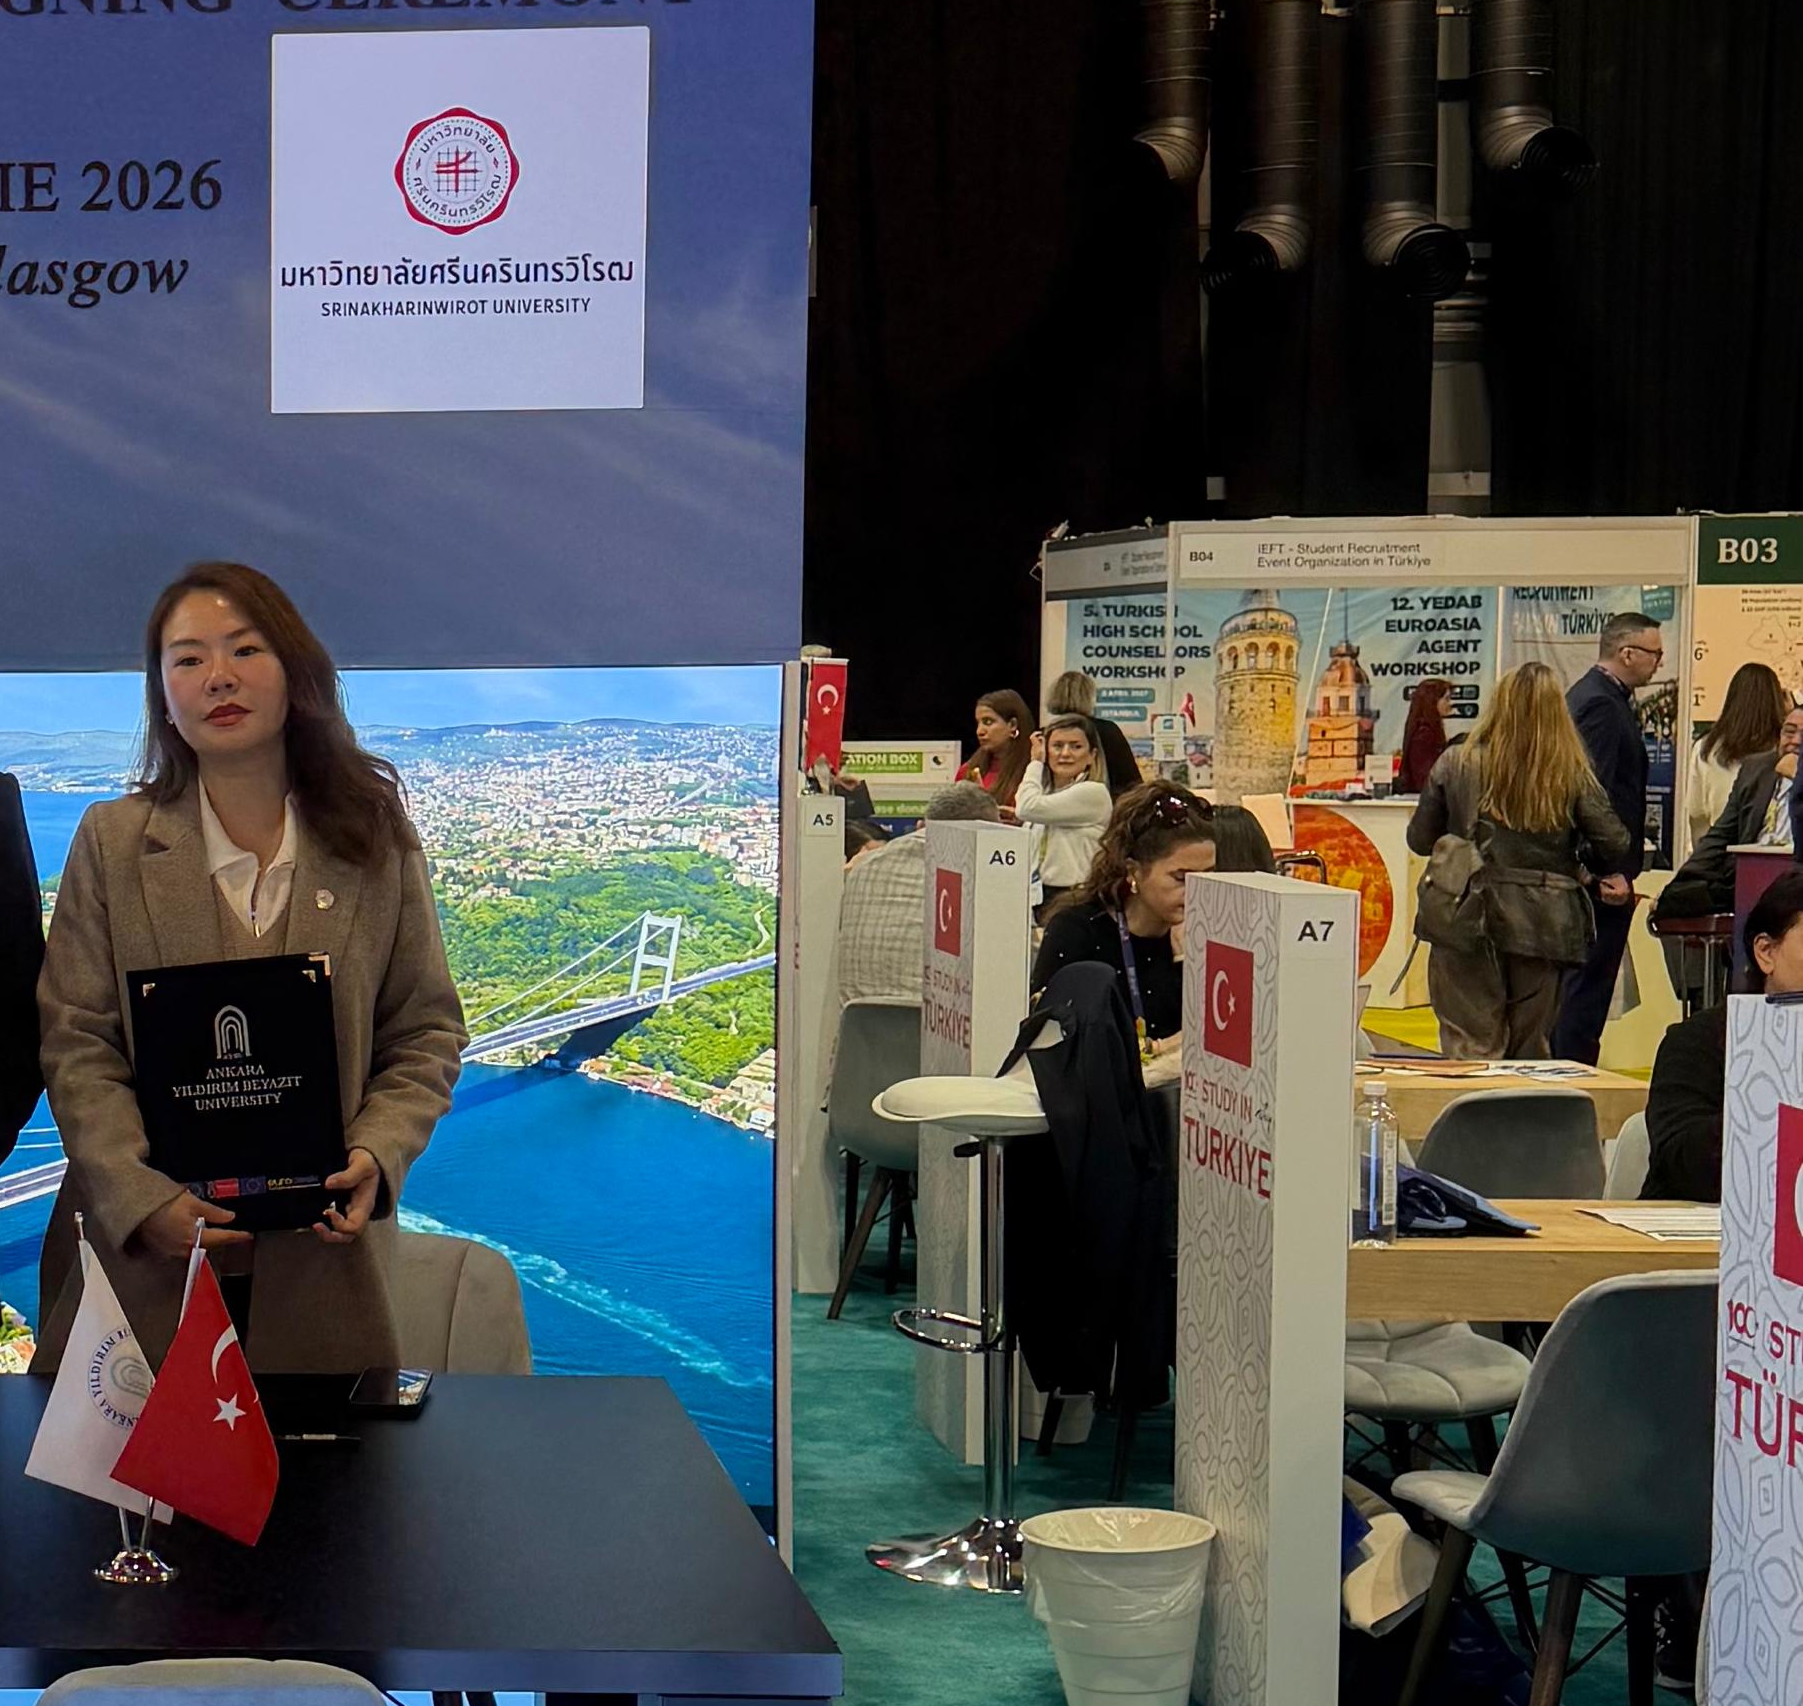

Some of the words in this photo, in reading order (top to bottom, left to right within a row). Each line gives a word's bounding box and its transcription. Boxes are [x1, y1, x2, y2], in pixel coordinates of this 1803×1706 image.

[80, 159, 223, 212] 2026
[281, 253, 634, 287] มหาวิทยาลัยศรีนครินทรวิโรฒ
[321, 299, 488, 317] SRINAKHARINWIROT
[493, 297, 591, 314] UNIVERSITY
[1297, 543, 1345, 554] Student
[1347, 542, 1421, 554] Recruitment
[1718, 537, 1778, 564] B03
[1189, 551, 1213, 562] B04
[1257, 557, 1291, 568] Event
[1294, 555, 1372, 570] Organization
[1373, 555, 1384, 566] in
[1391, 596, 1414, 611] 12.
[1419, 595, 1483, 610] YEDAB
[1083, 625, 1125, 638] HIGH
[1129, 624, 1203, 638] SCHOL
[1385, 617, 1482, 633] EUROASIA
[1083, 645, 1211, 659] COUNSELORS
[1417, 639, 1482, 654] AGENT
[1370, 661, 1481, 677] WORKSHOP
[846, 753, 887, 765] ATION
[890, 753, 918, 765] BOX
[813, 814, 834, 826] A5
[989, 850, 1016, 866] A6
[1298, 921, 1335, 942] A7
[206, 1064, 265, 1080] ANKARA
[172, 1080, 240, 1098] YILDIRIM
[243, 1076, 303, 1092] BEYAZIT
[195, 1092, 283, 1111] UNIVERSITY
[1201, 1079, 1236, 1113] STUDY
[1237, 1089, 1253, 1123] IN
[1184, 1112, 1271, 1199] TÜRKİYE
[1770, 1321, 1803, 1366] ST
